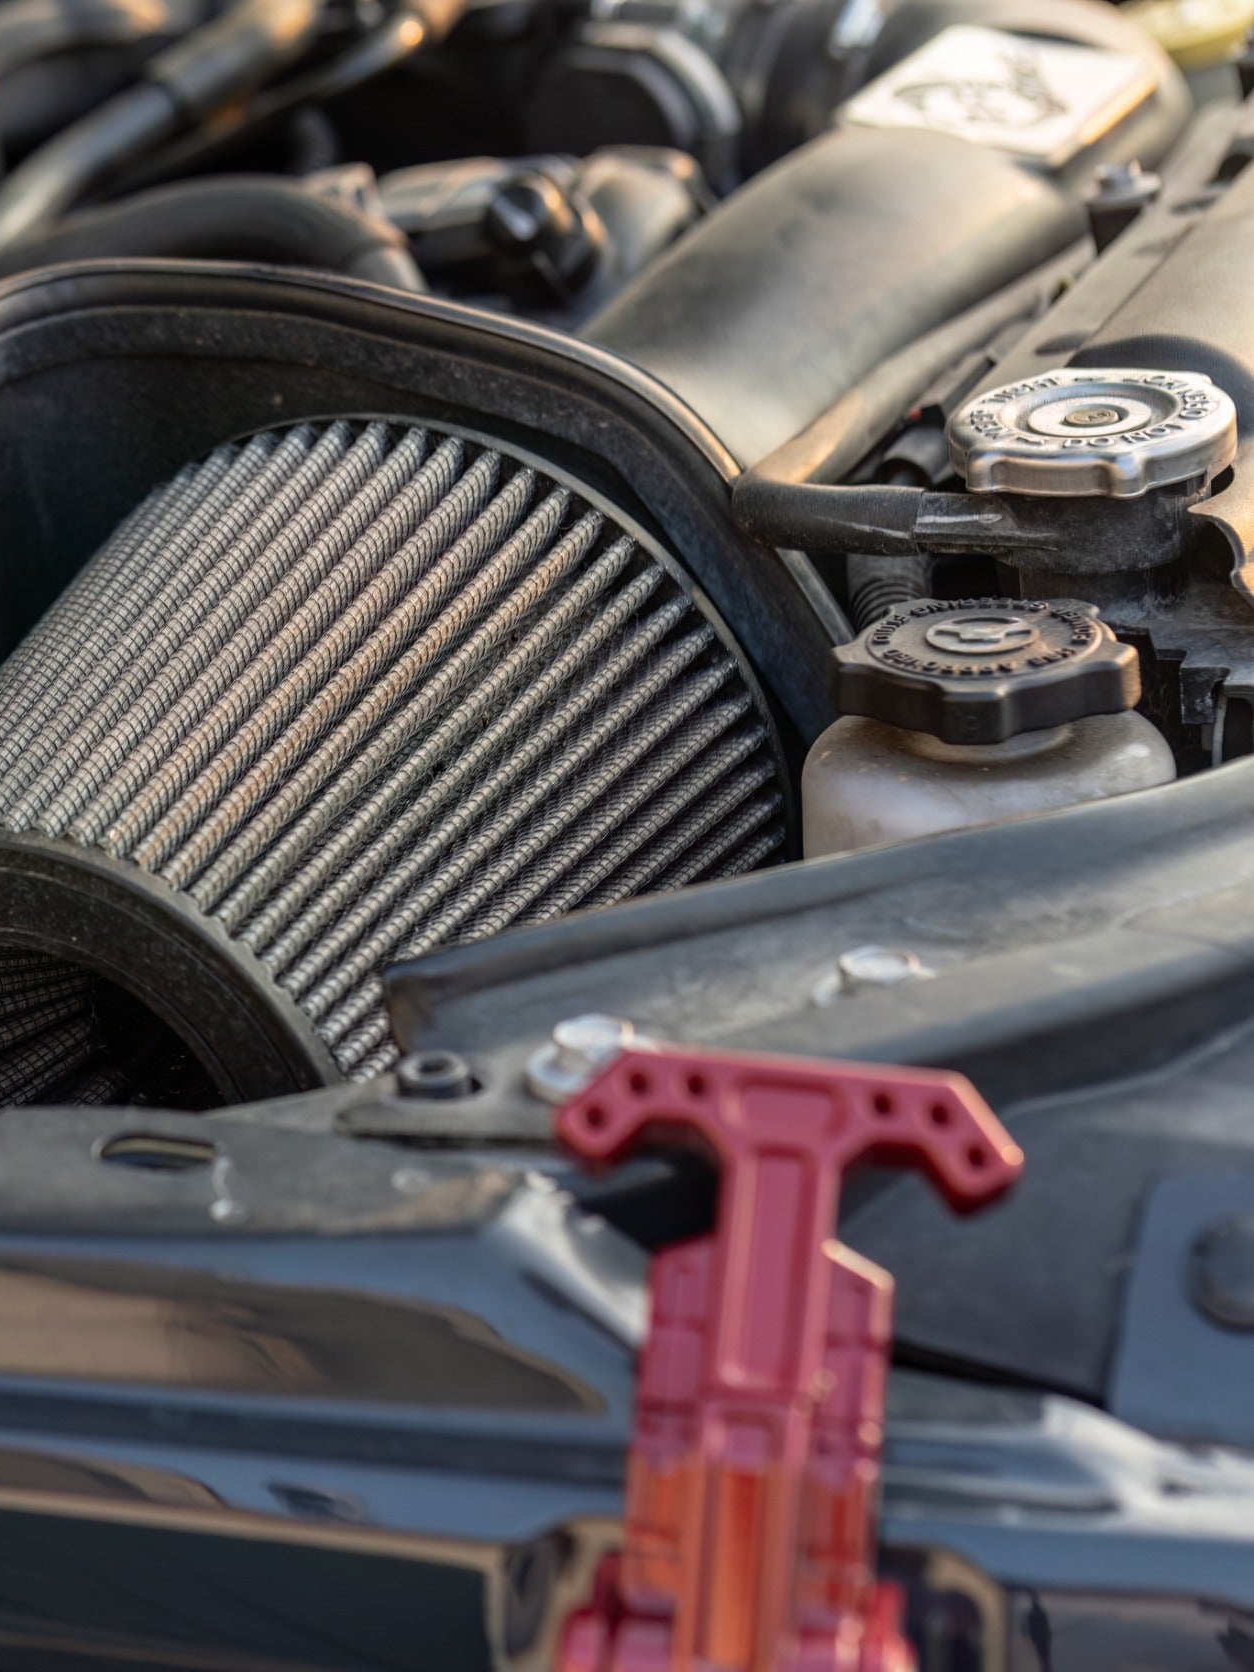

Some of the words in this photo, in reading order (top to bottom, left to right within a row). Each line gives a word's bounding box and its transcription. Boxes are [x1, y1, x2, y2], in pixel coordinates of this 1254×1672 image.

[1062, 436, 1115, 448] DO
[1121, 422, 1184, 444] NOT
[909, 597, 1049, 619] STEERING
[872, 614, 910, 645] FLUID
[1049, 605, 1092, 646] POWER
